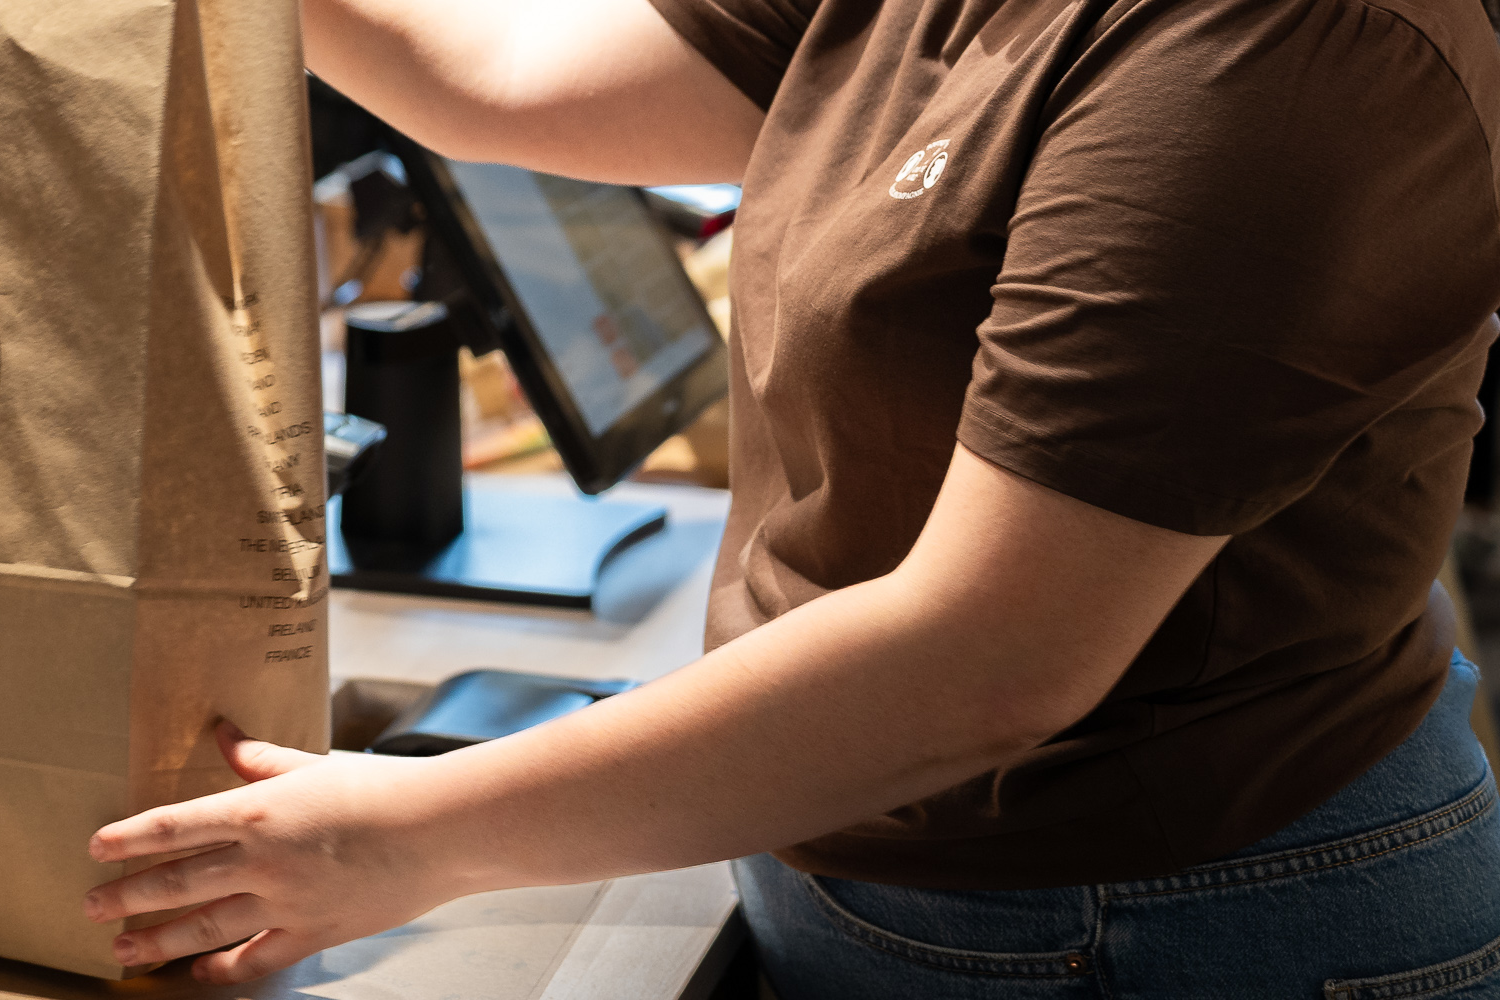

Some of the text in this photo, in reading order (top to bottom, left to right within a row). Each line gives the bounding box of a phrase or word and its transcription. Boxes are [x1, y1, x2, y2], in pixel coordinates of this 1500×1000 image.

[239, 538, 266, 553] THE
[239, 594, 291, 610] UNITED
[264, 645, 314, 664] FRANCE
